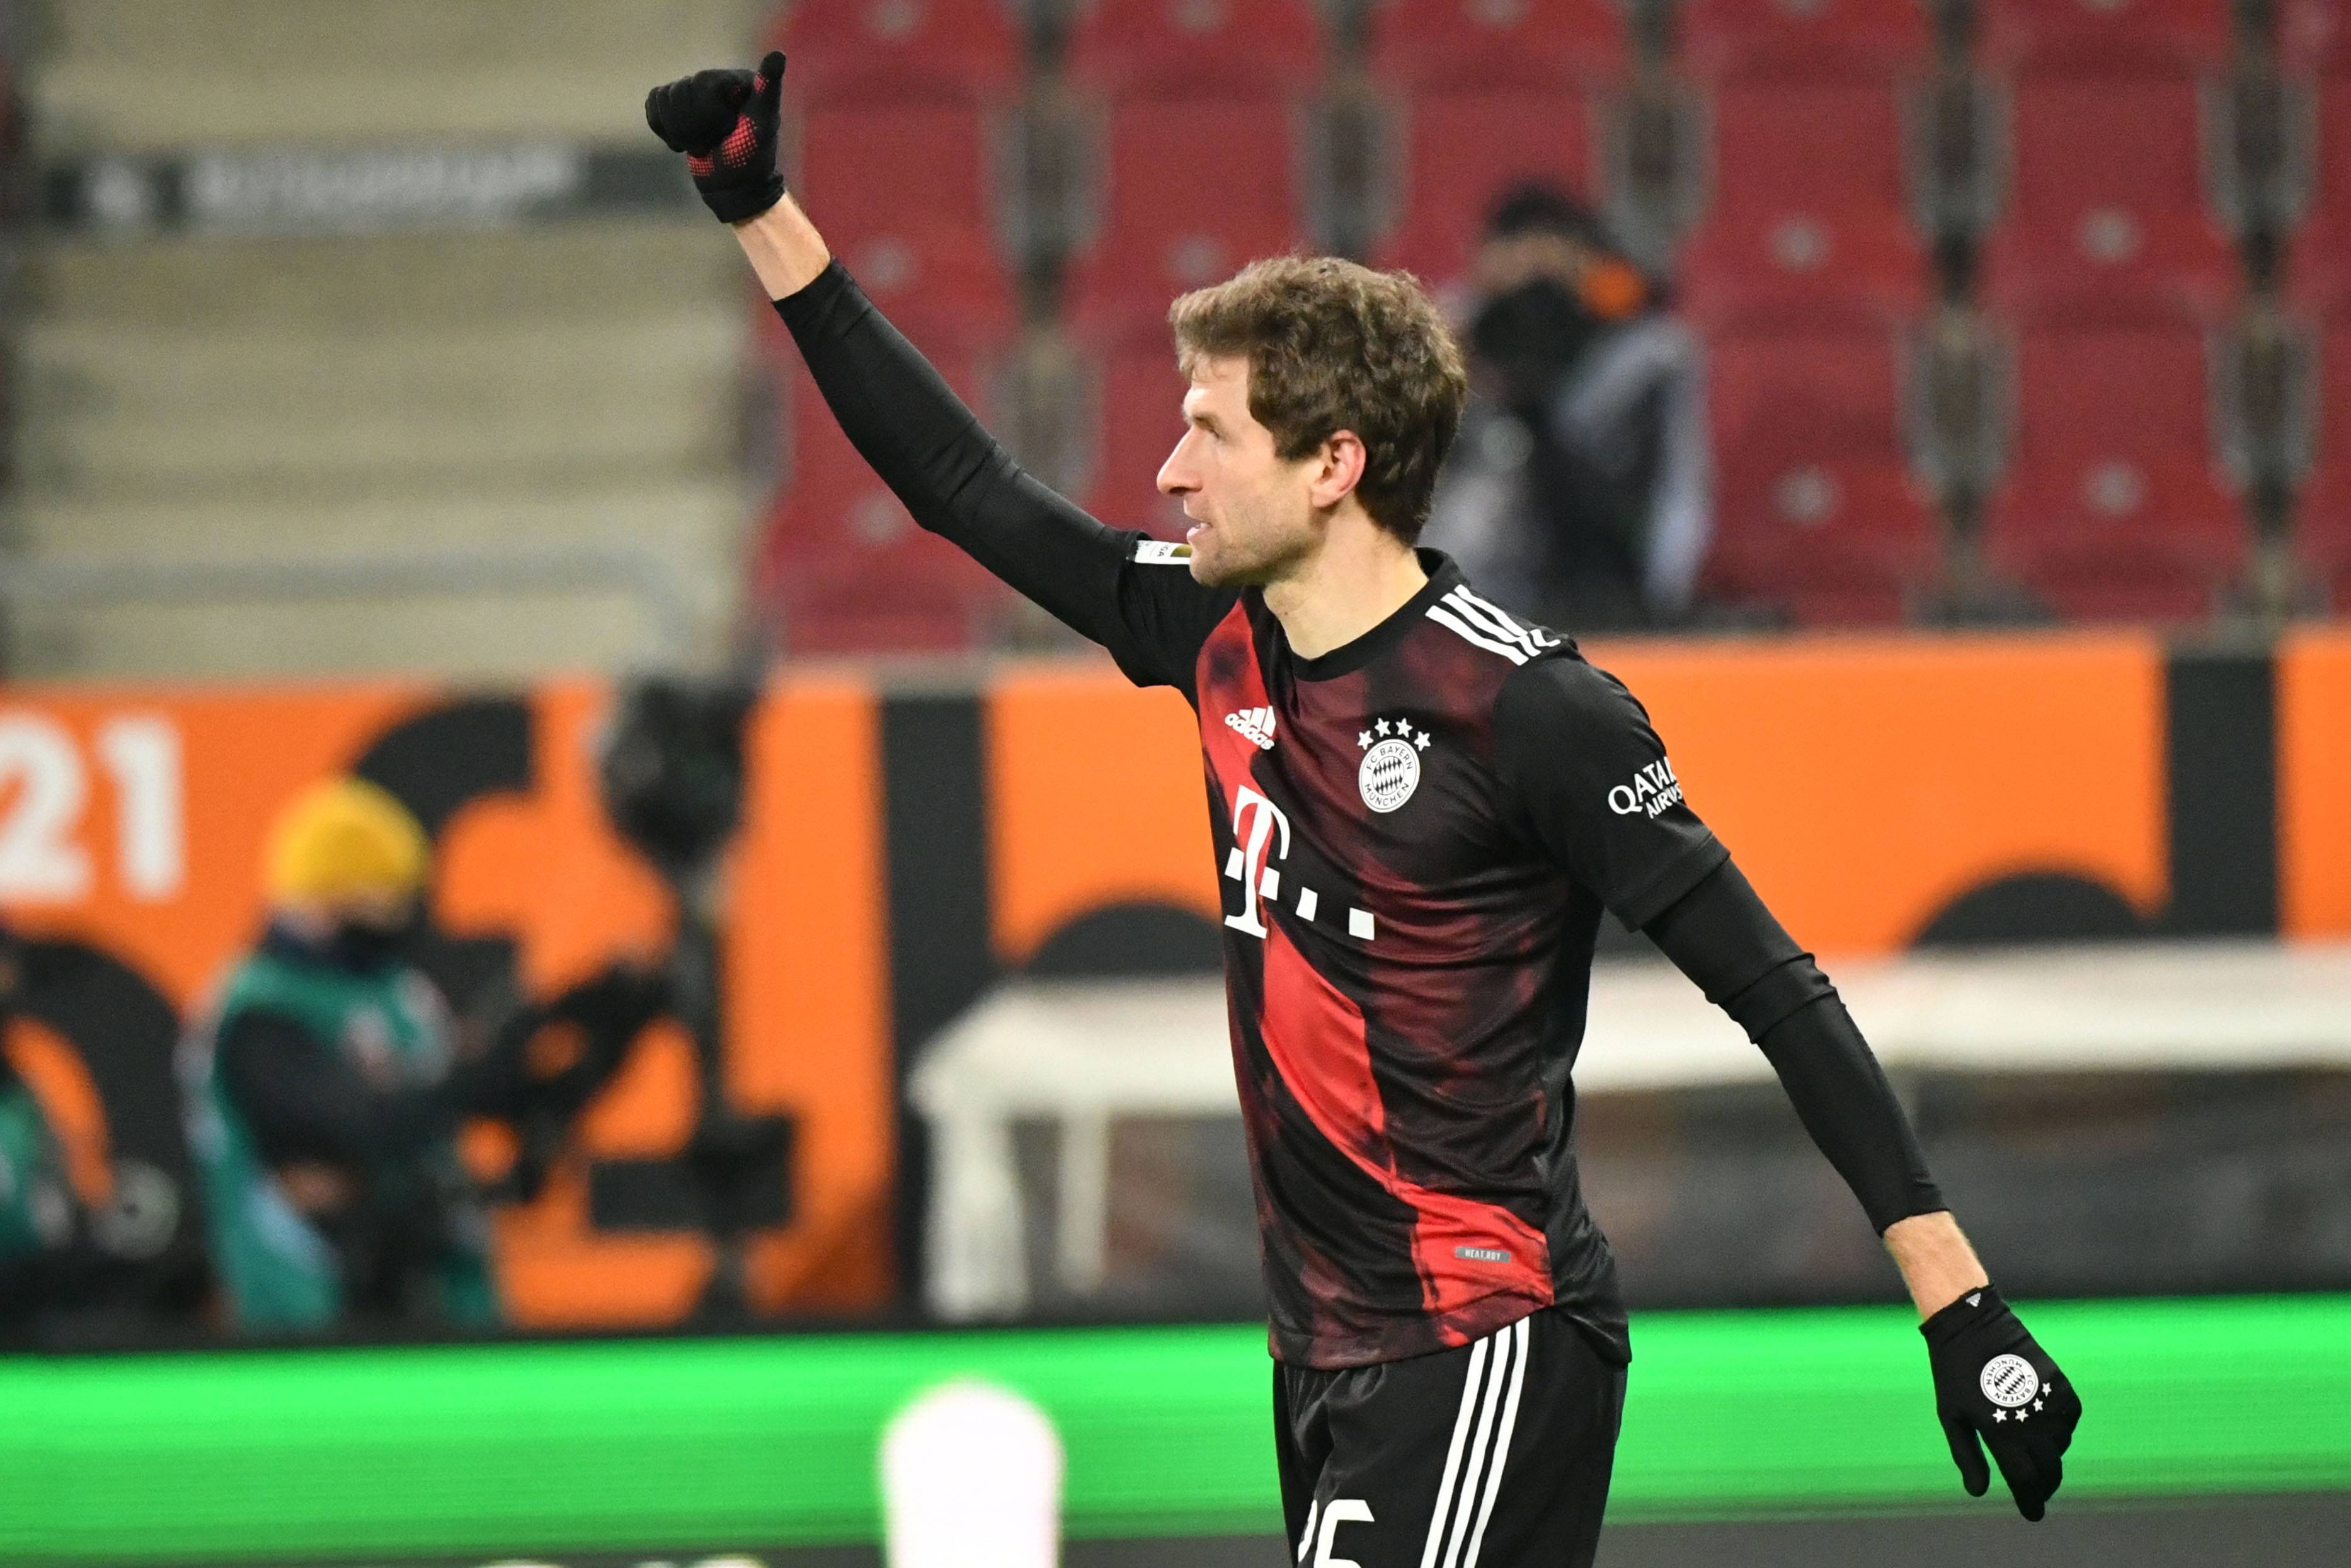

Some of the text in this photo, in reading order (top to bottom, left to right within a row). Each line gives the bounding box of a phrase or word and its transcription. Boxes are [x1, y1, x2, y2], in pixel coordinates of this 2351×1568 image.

[1224, 712, 1275, 750] adidas
[1366, 745, 1413, 770] FC BAYERN
[1994, 1388, 2031, 1402] BAYERN
